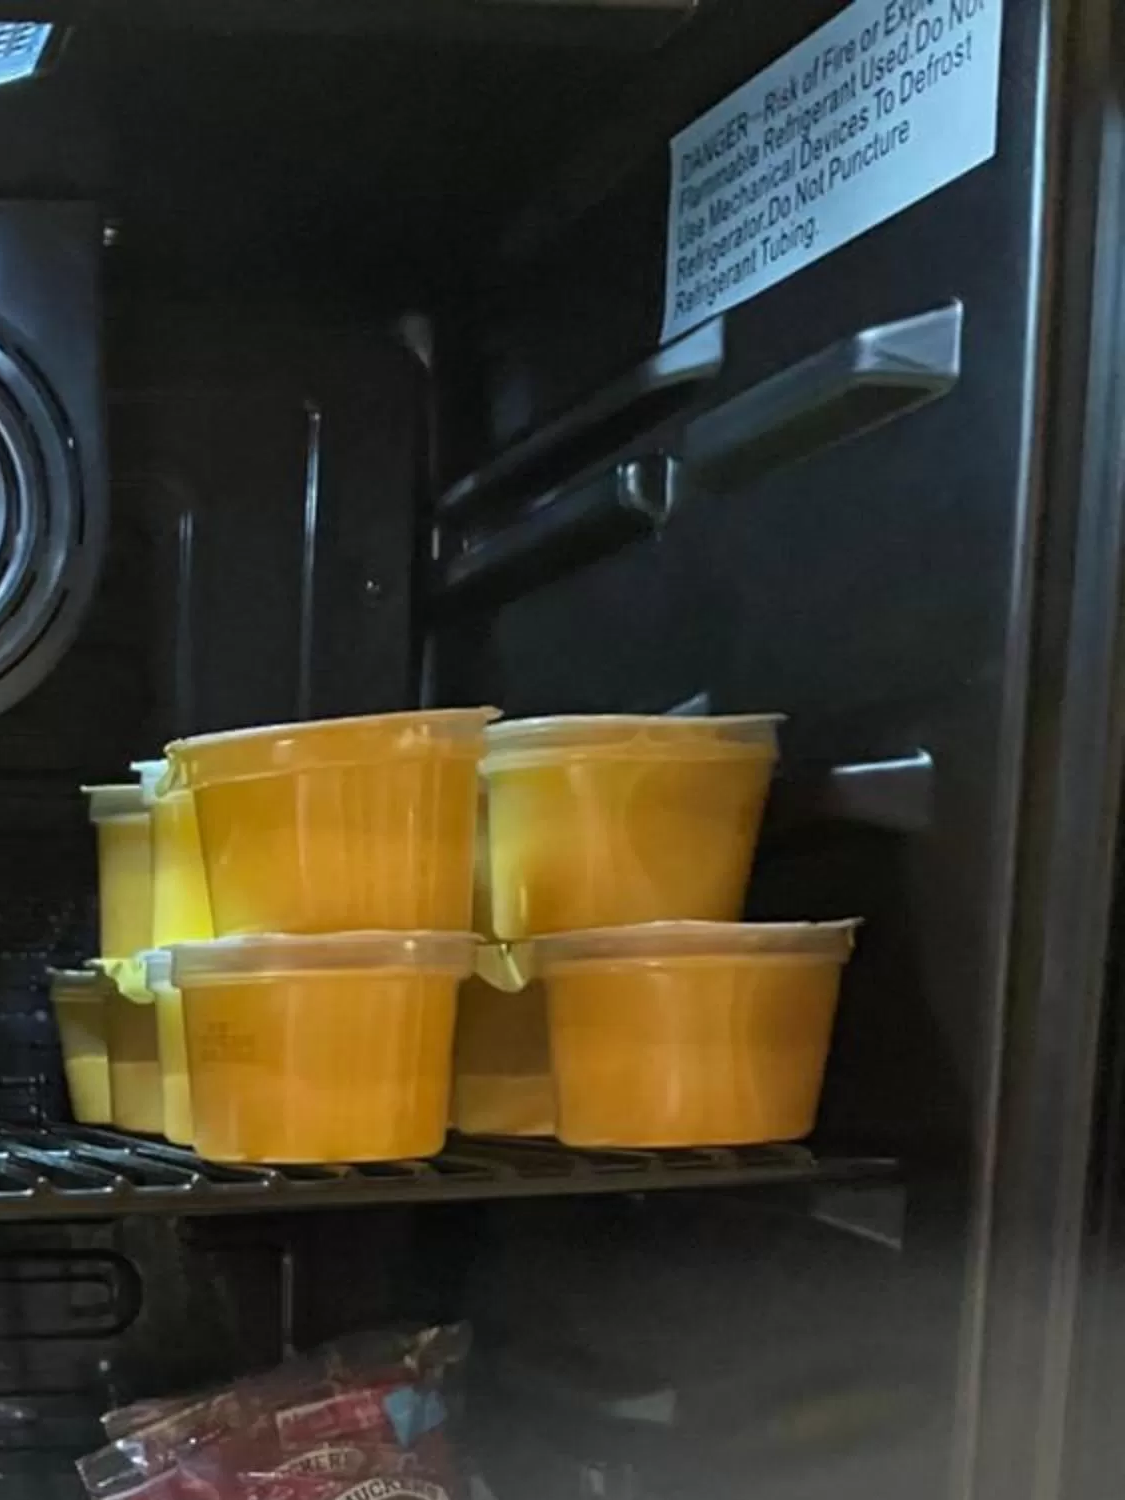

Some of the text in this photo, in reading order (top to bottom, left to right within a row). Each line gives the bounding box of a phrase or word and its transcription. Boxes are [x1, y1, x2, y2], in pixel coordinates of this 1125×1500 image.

[823, 39, 856, 78] Fire
[860, 20, 880, 52] or
[678, 31, 972, 250] Use Mechanical Devices To Defrost
[763, 72, 856, 158] Refrigerant
[795, 168, 824, 212] Not
[828, 119, 910, 190] Puncture
[675, 249, 757, 320] Refrigerant
